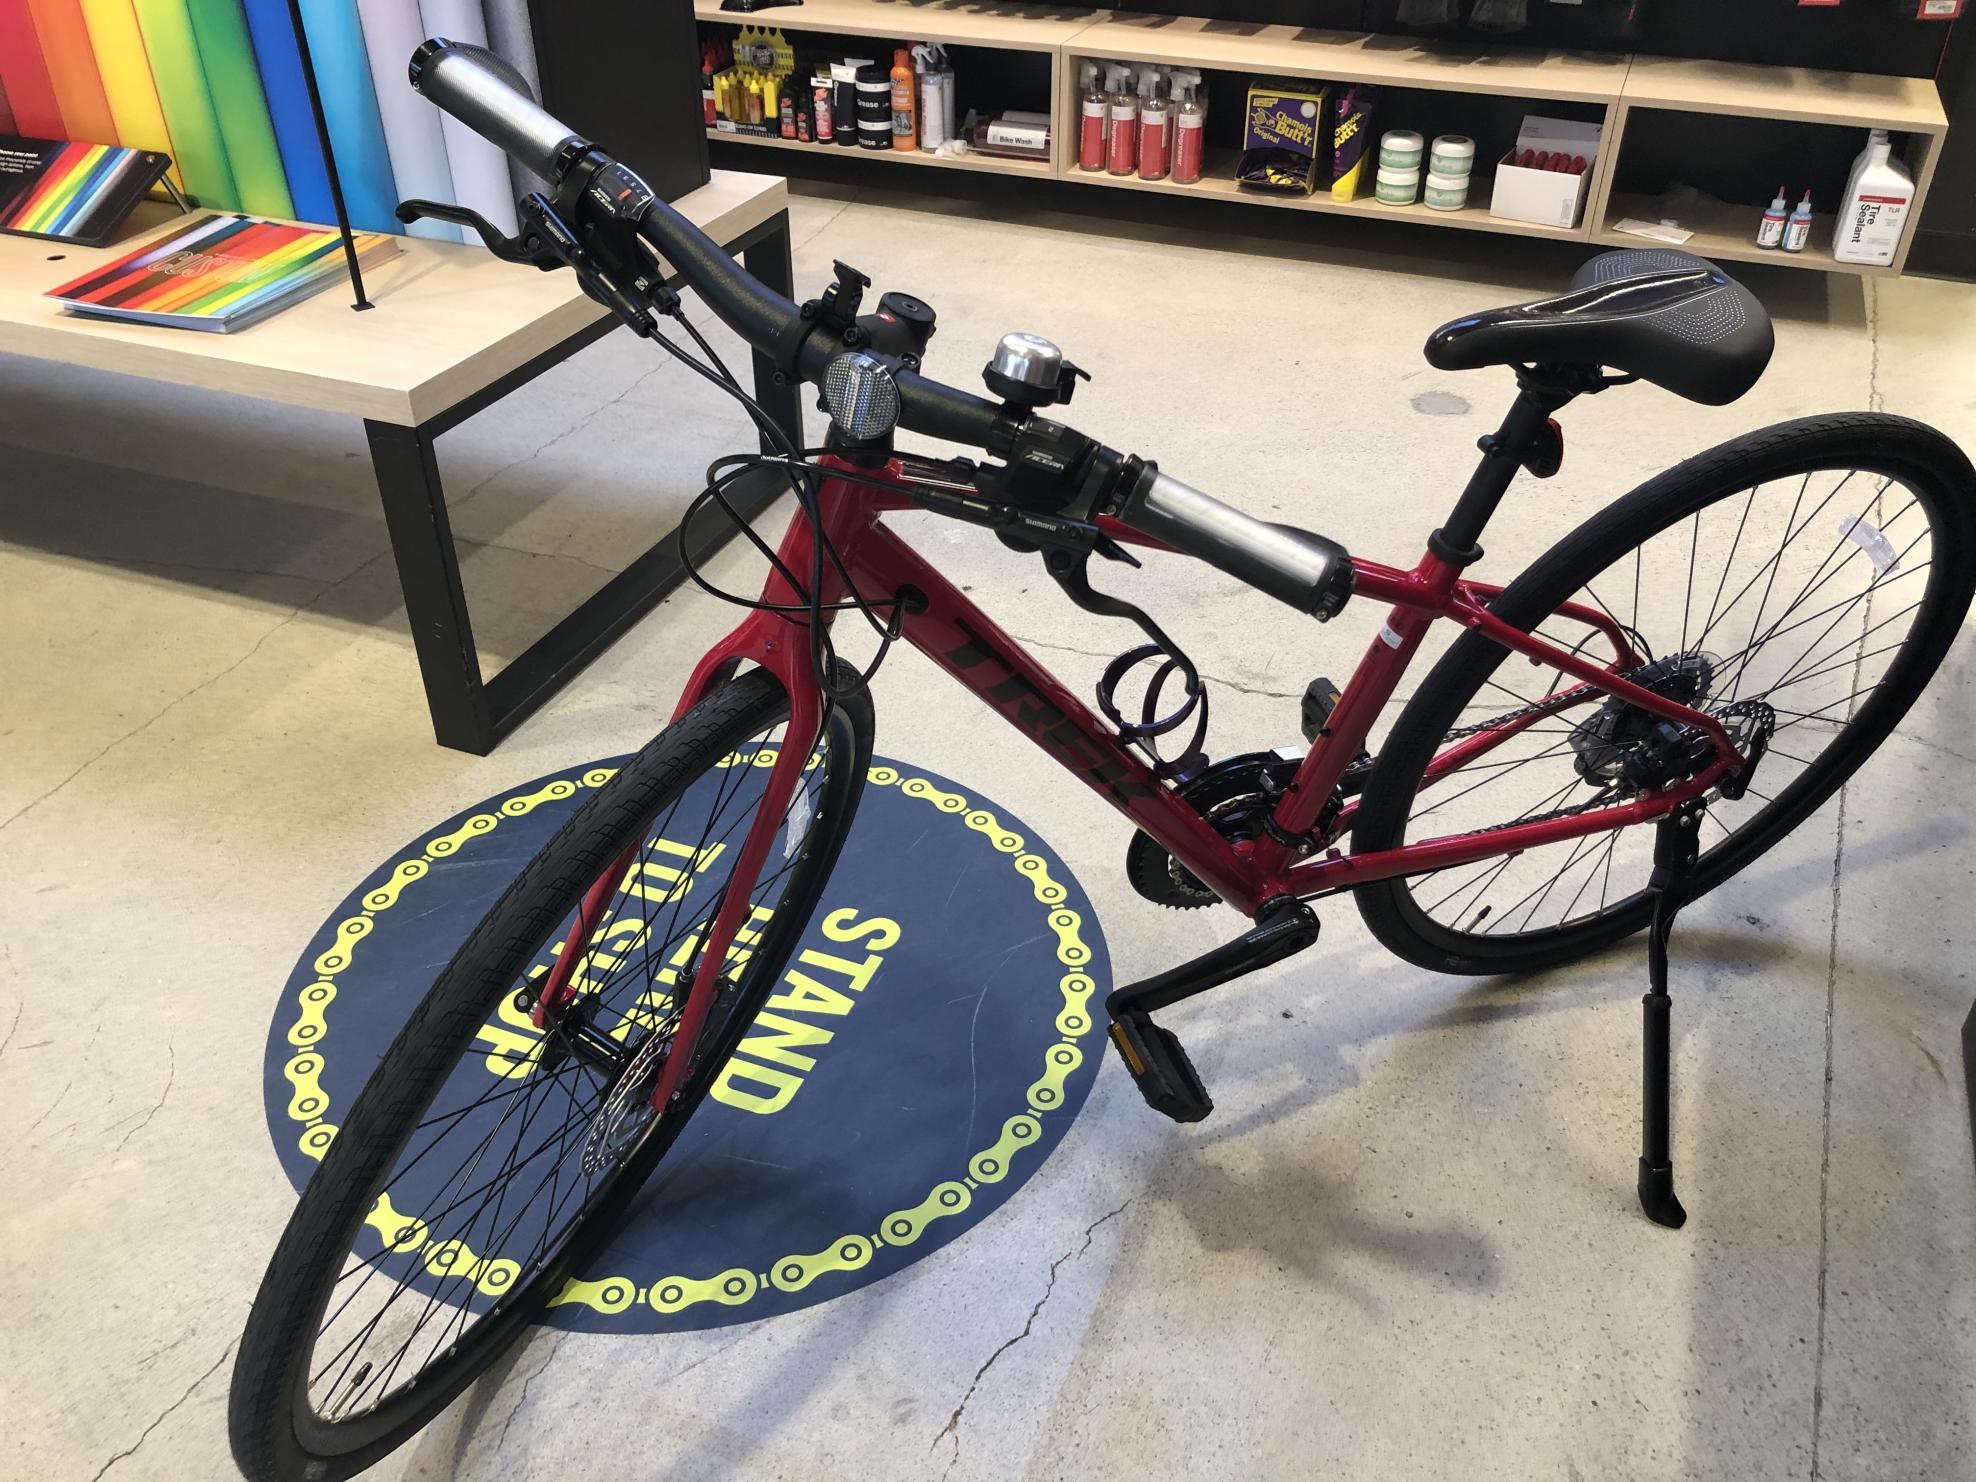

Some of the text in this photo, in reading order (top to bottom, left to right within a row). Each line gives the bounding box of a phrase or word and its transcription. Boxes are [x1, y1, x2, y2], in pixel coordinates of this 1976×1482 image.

[1000, 136, 1032, 145] Bike Wash
[1253, 127, 1280, 144] Original
[1276, 111, 1312, 134] Chamois
[1177, 128, 1185, 166] Degreaser
[1851, 204, 1870, 243] Sealant
[1866, 205, 1881, 225] Tire
[944, 616, 1158, 806] TREK
[620, 837, 727, 904] TO
[709, 907, 902, 1115] STAND
